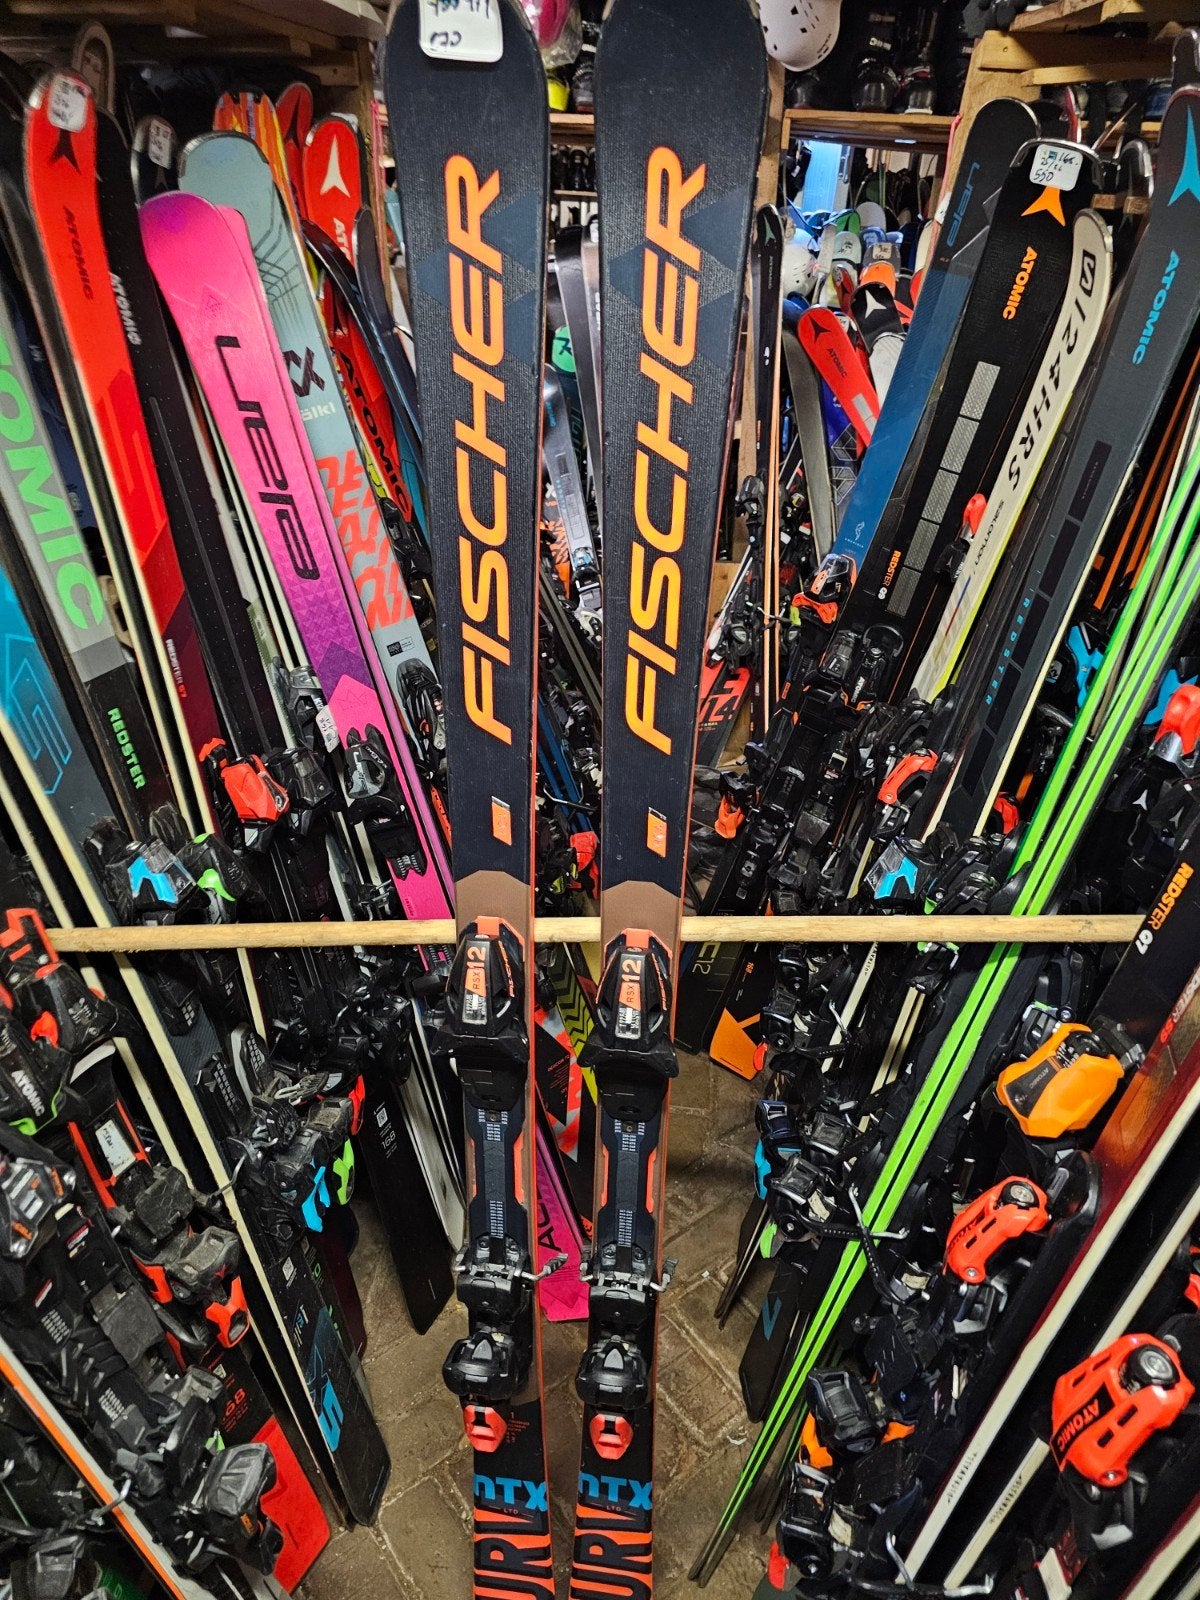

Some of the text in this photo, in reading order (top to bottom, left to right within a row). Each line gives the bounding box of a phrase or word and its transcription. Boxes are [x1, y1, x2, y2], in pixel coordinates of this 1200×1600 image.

[63, 205, 94, 301] ATOMIC
[1002, 246, 1038, 320] ATOMIC
[1132, 250, 1180, 365] ATOMIC
[826, 347, 848, 379] ATOMIC
[300, 401, 336, 422] ölkl
[339, 349, 410, 514] ATOMIC
[0, 335, 104, 631] OMIC
[215, 335, 321, 581] elan
[444, 154, 512, 746] FISCHER
[624, 145, 706, 756] FISCHER
[882, 550, 902, 587] REDSTER
[984, 596, 1030, 706] REDSTER
[107, 707, 147, 790] REDSTER
[1147, 862, 1195, 930] REDSTER
[466, 946, 487, 968] 12
[472, 970, 480, 990] RSX
[621, 959, 643, 982] 12
[626, 984, 635, 1003] RSX
[10, 1069, 46, 1117] ATOMIC
[1057, 1398, 1100, 1453] ATOMIC
